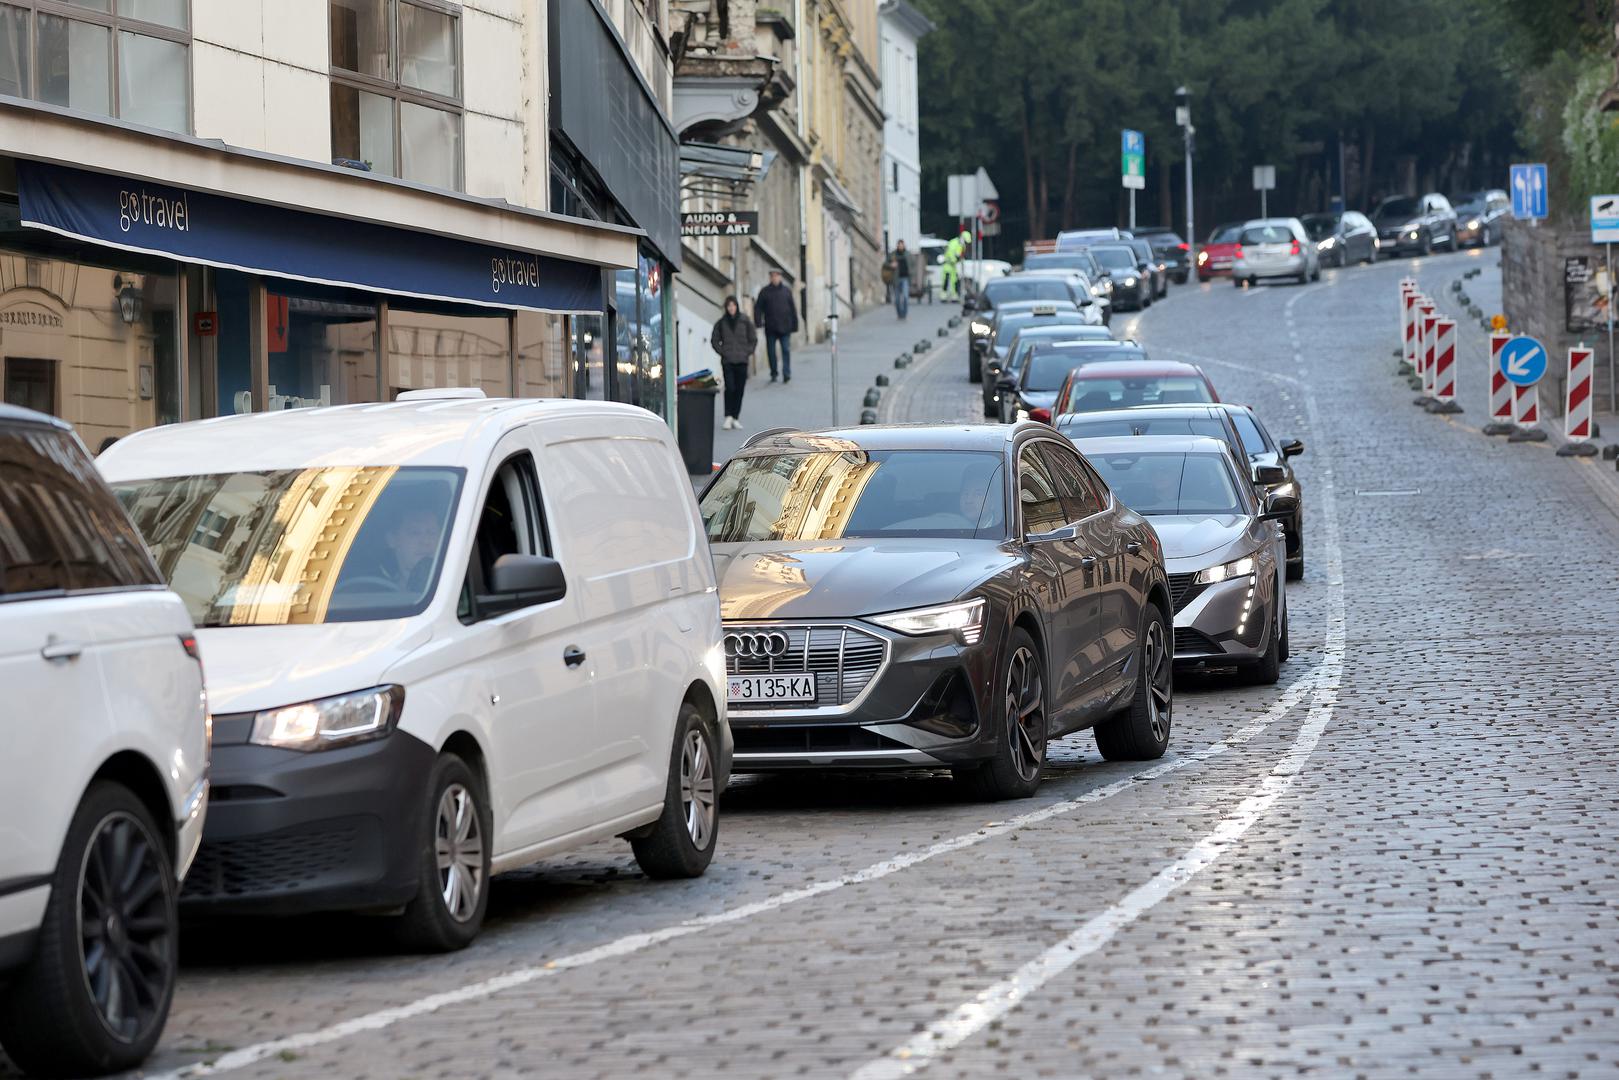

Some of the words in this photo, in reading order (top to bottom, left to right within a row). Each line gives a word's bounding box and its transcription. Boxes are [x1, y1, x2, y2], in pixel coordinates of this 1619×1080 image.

[685, 213, 725, 224] AUDIO
[727, 213, 737, 223] &
[681, 224, 720, 235] INEMA
[725, 224, 751, 234] ART
